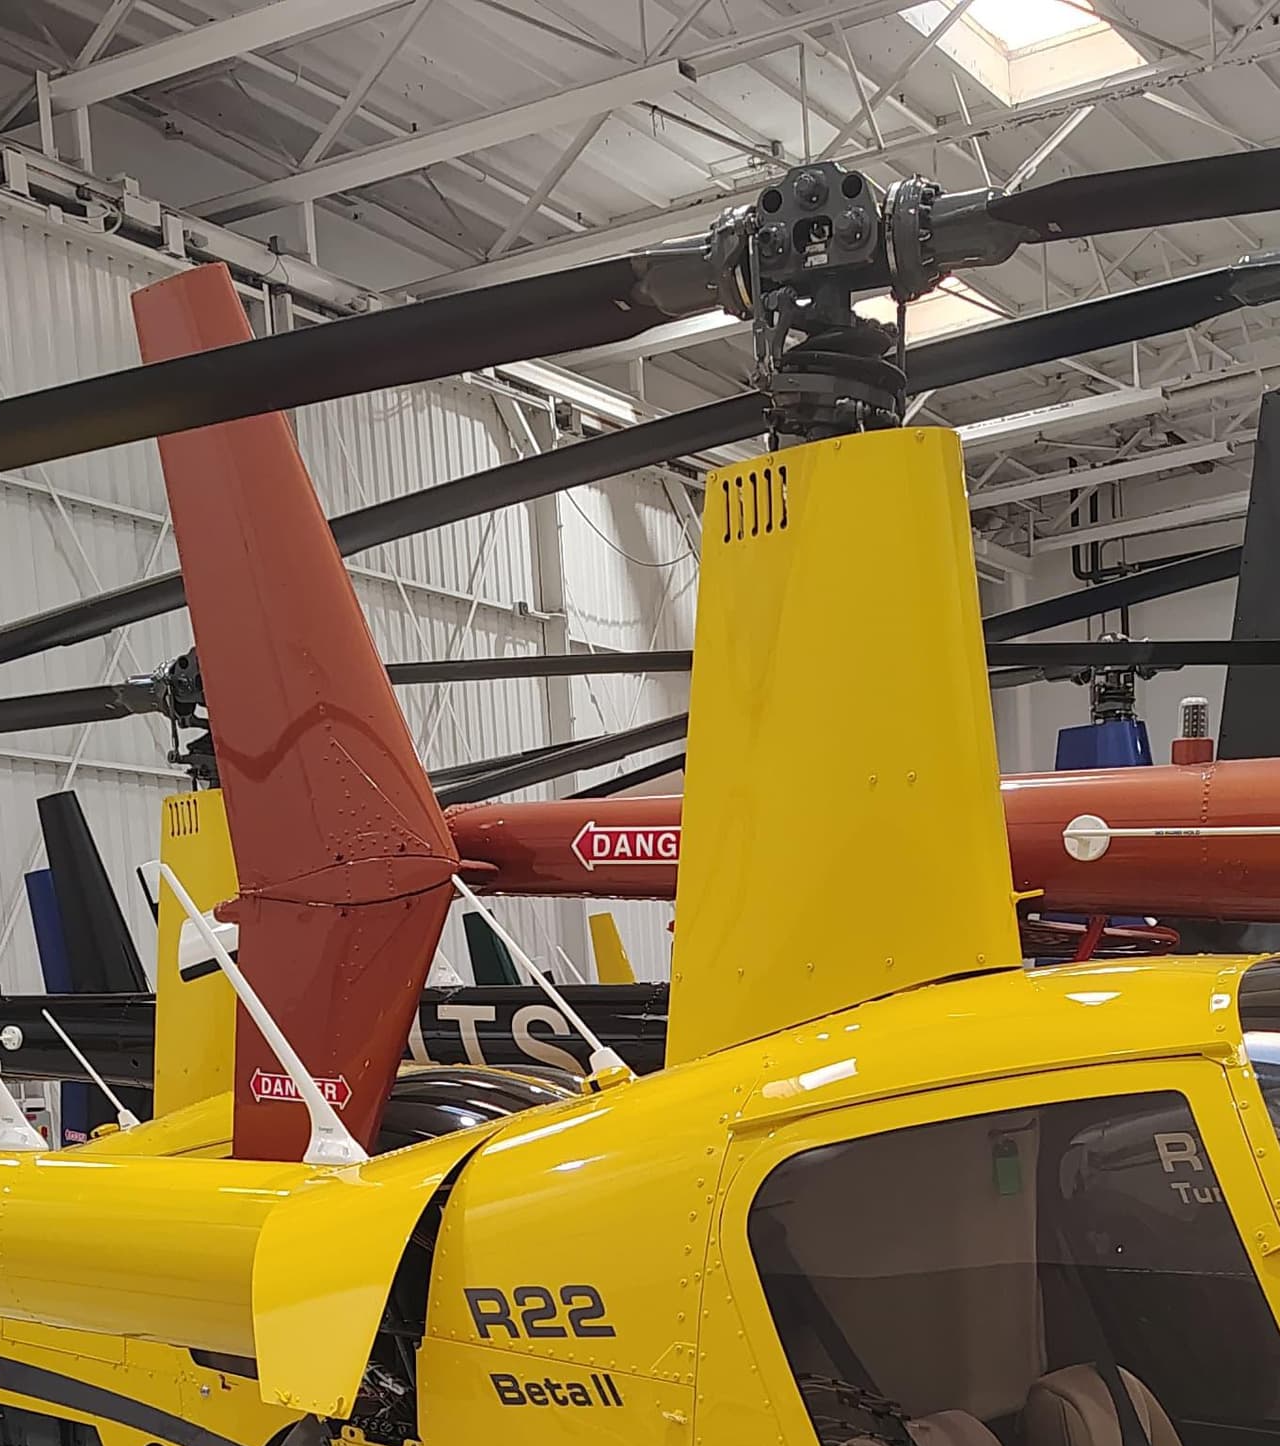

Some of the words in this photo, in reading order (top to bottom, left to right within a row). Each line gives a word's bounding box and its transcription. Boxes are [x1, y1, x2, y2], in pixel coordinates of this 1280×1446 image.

[592, 832, 678, 858] DANG
[260, 1077, 337, 1101] DANR
[463, 1284, 617, 1339] R22
[489, 1372, 594, 1407] Beta
